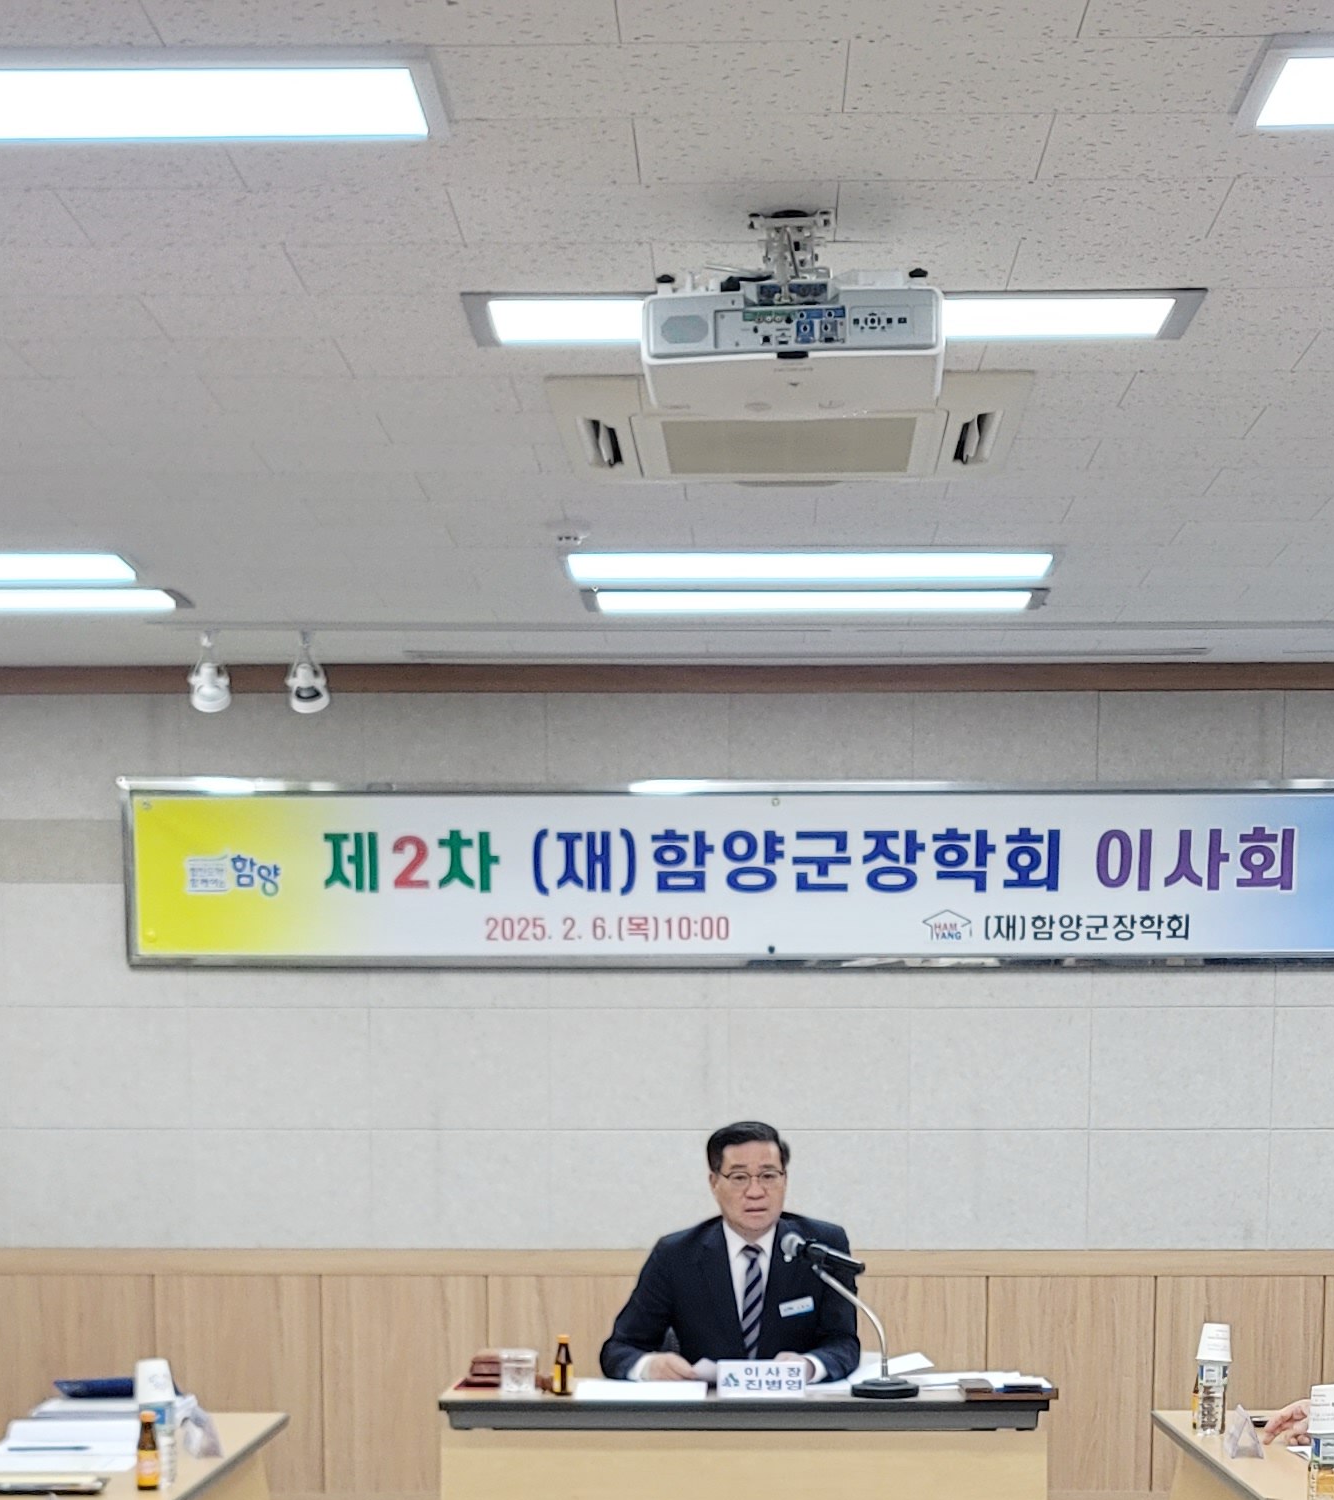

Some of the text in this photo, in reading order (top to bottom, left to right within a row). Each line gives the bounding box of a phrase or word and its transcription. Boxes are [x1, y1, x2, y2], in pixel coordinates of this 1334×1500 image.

[323, 826, 1295, 896] 제2차 (재)함양군장학회 이사회
[230, 854, 280, 897] 함양
[485, 916, 552, 941] 2025.
[562, 916, 582, 941] 2.
[933, 931, 962, 941] YANG
[934, 922, 957, 931] HAM
[984, 913, 1190, 941] (재)함양군장학회
[745, 1379, 803, 1392] 진병영
